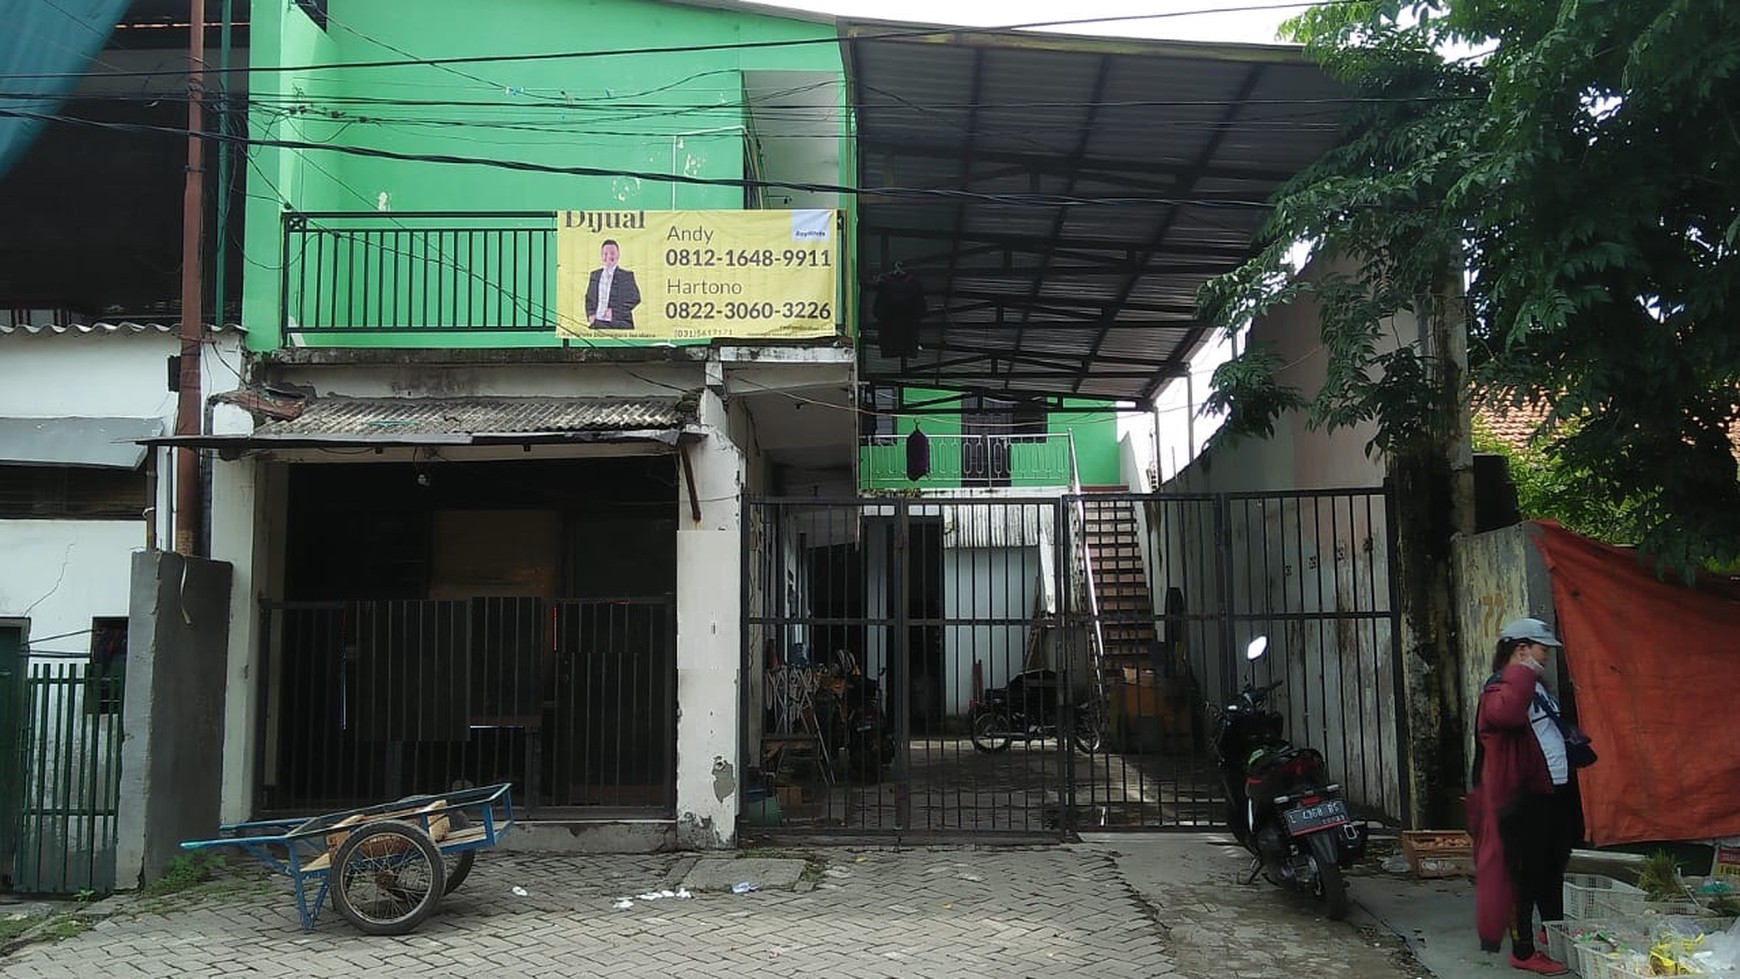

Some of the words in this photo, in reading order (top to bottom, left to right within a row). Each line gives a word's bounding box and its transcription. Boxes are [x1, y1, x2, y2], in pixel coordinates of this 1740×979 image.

[566, 210, 645, 233] Dijual
[666, 226, 714, 245] Andy
[665, 249, 831, 267] 0812-1648-9911
[666, 278, 742, 295] Hartono
[665, 302, 831, 320] 0822-3060-3226
